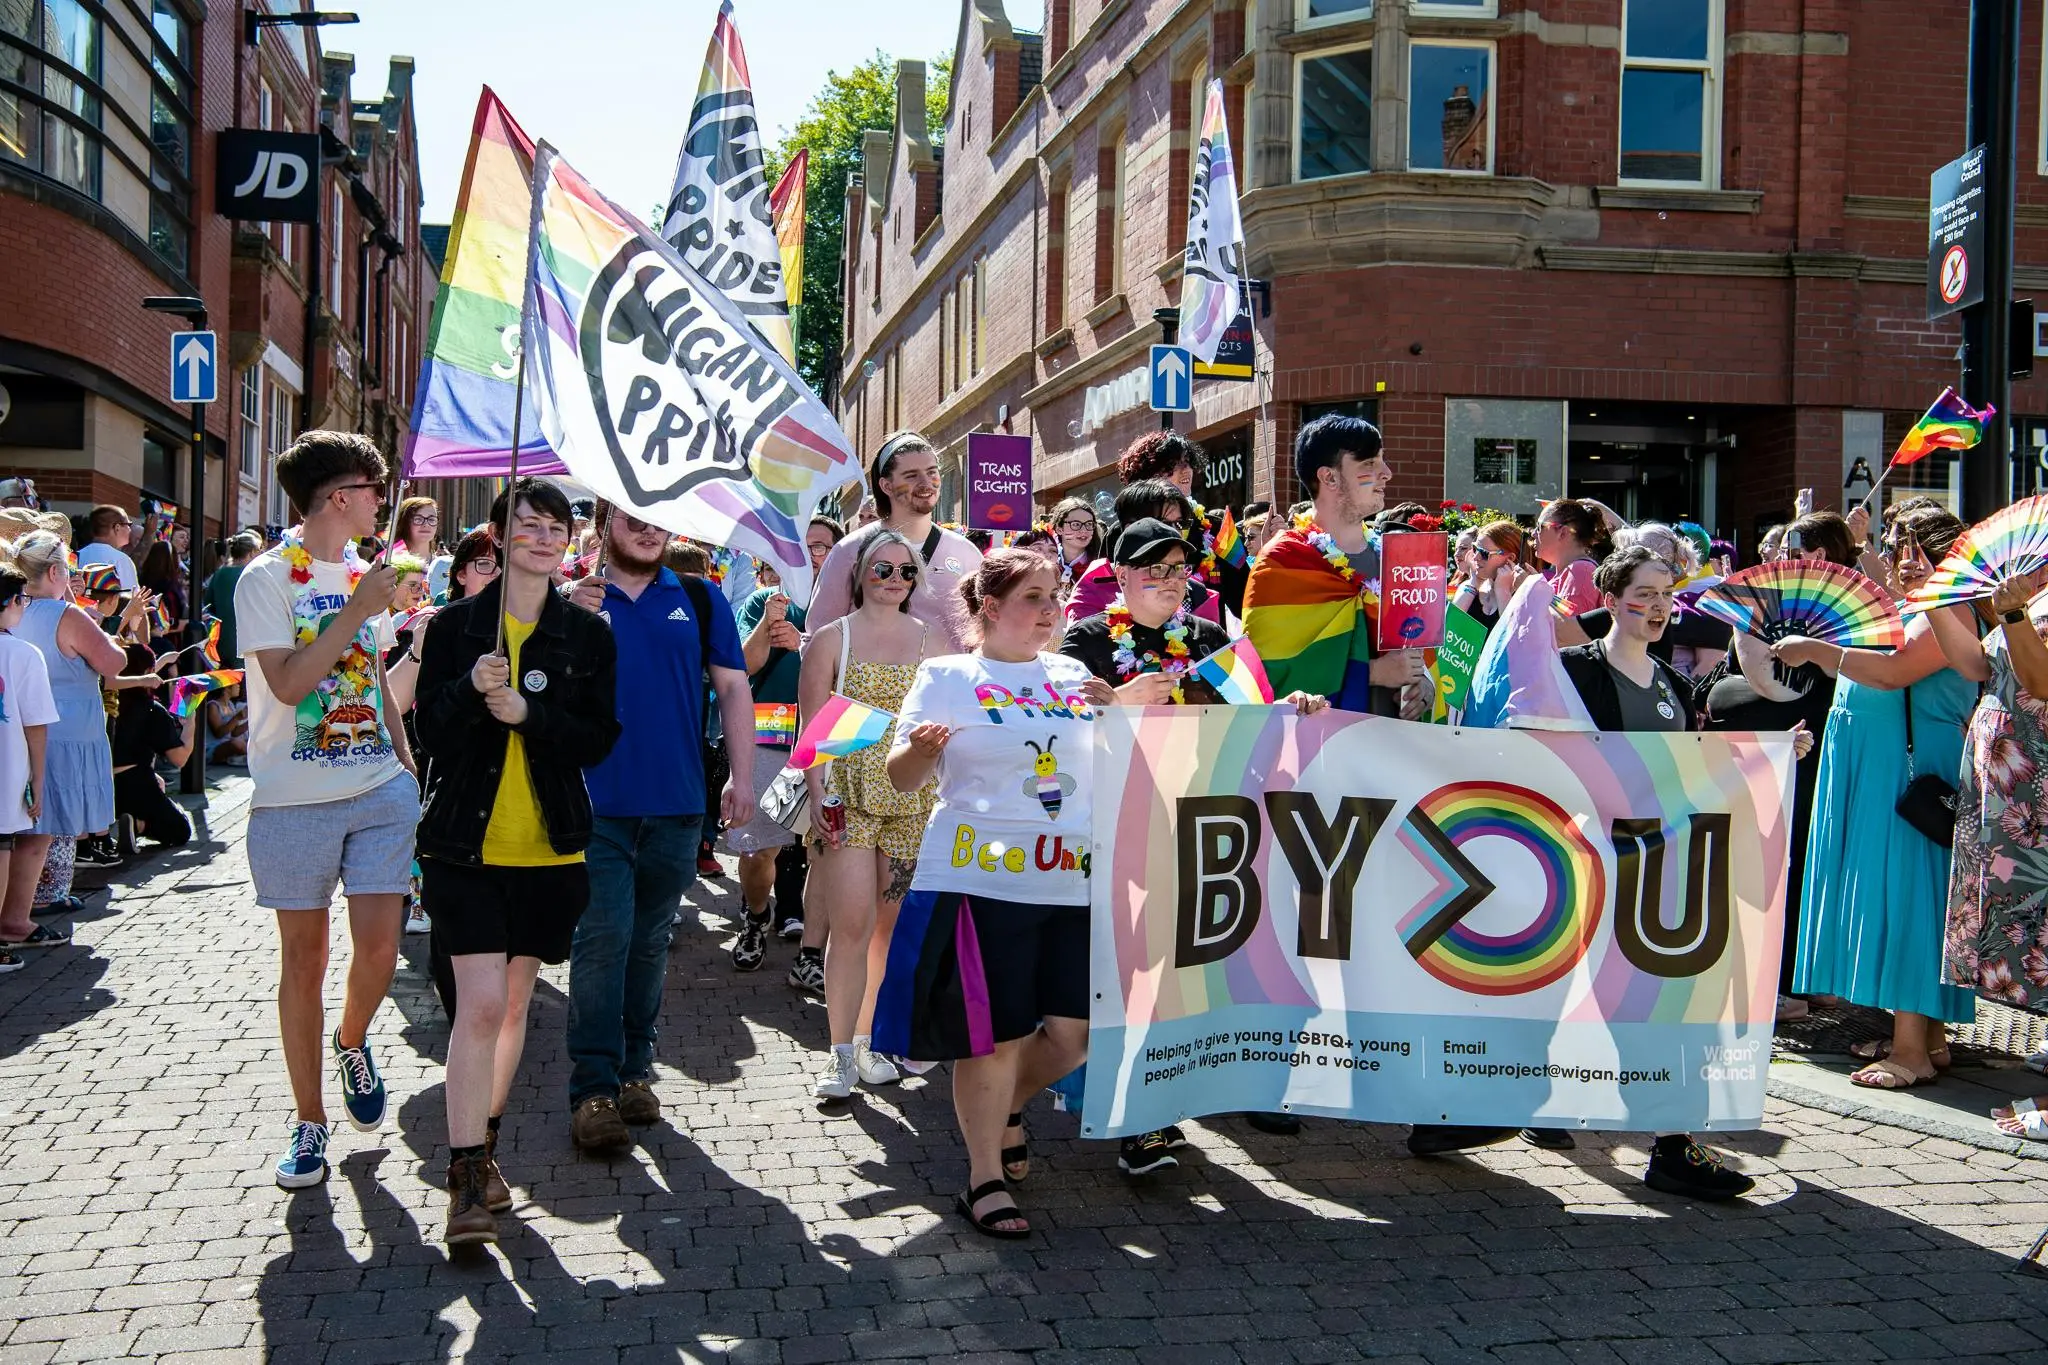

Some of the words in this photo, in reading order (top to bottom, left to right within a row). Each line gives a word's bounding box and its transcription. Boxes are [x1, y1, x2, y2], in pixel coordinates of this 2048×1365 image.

[233, 151, 309, 199] JD
[1961, 164, 1981, 183] Council
[1962, 156, 1980, 172] Wigan
[1956, 186, 1982, 205] cigarettes
[1934, 227, 1944, 240] you
[1944, 220, 1958, 234] could
[1958, 214, 1970, 226] face
[1970, 212, 1977, 221] an
[663, 184, 782, 295] PRIDE
[607, 265, 783, 403] WIGAN
[1220, 341, 1242, 351] OTS
[1081, 365, 1149, 435] ADMIR
[979, 461, 1022, 477] TRANS
[1205, 453, 1243, 489] SLOTS
[974, 479, 1027, 496] RIGHTS
[1391, 565, 1439, 583] PRIDE
[1390, 588, 1438, 606] PROUD
[1446, 630, 1474, 657] BYOU
[1437, 645, 1473, 676] WIGAN
[975, 682, 1094, 724] Pride
[320, 760, 328, 768] IN
[332, 759, 358, 768] BRAIN
[952, 824, 1026, 873] Bee
[1034, 834, 1092, 879] Uniq
[1145, 1041, 1192, 1063] Helping
[1193, 1038, 1203, 1051] to
[1205, 1031, 1230, 1051] give
[1234, 1028, 1283, 1047] young
[1289, 1030, 1354, 1050] LGBTQ+
[1359, 1038, 1411, 1057] young
[1443, 1040, 1486, 1055] Email
[1704, 1044, 1752, 1066] Wigan
[1144, 1061, 1186, 1086] people
[1187, 1060, 1196, 1072] in
[1199, 1050, 1237, 1069] Wigan
[1241, 1047, 1311, 1068] Borough
[1316, 1054, 1328, 1066] a
[1333, 1055, 1381, 1072] voice
[1443, 1060, 1671, 1086] b.youproject@wigan.gov.uk
[1700, 1063, 1756, 1082] Council
